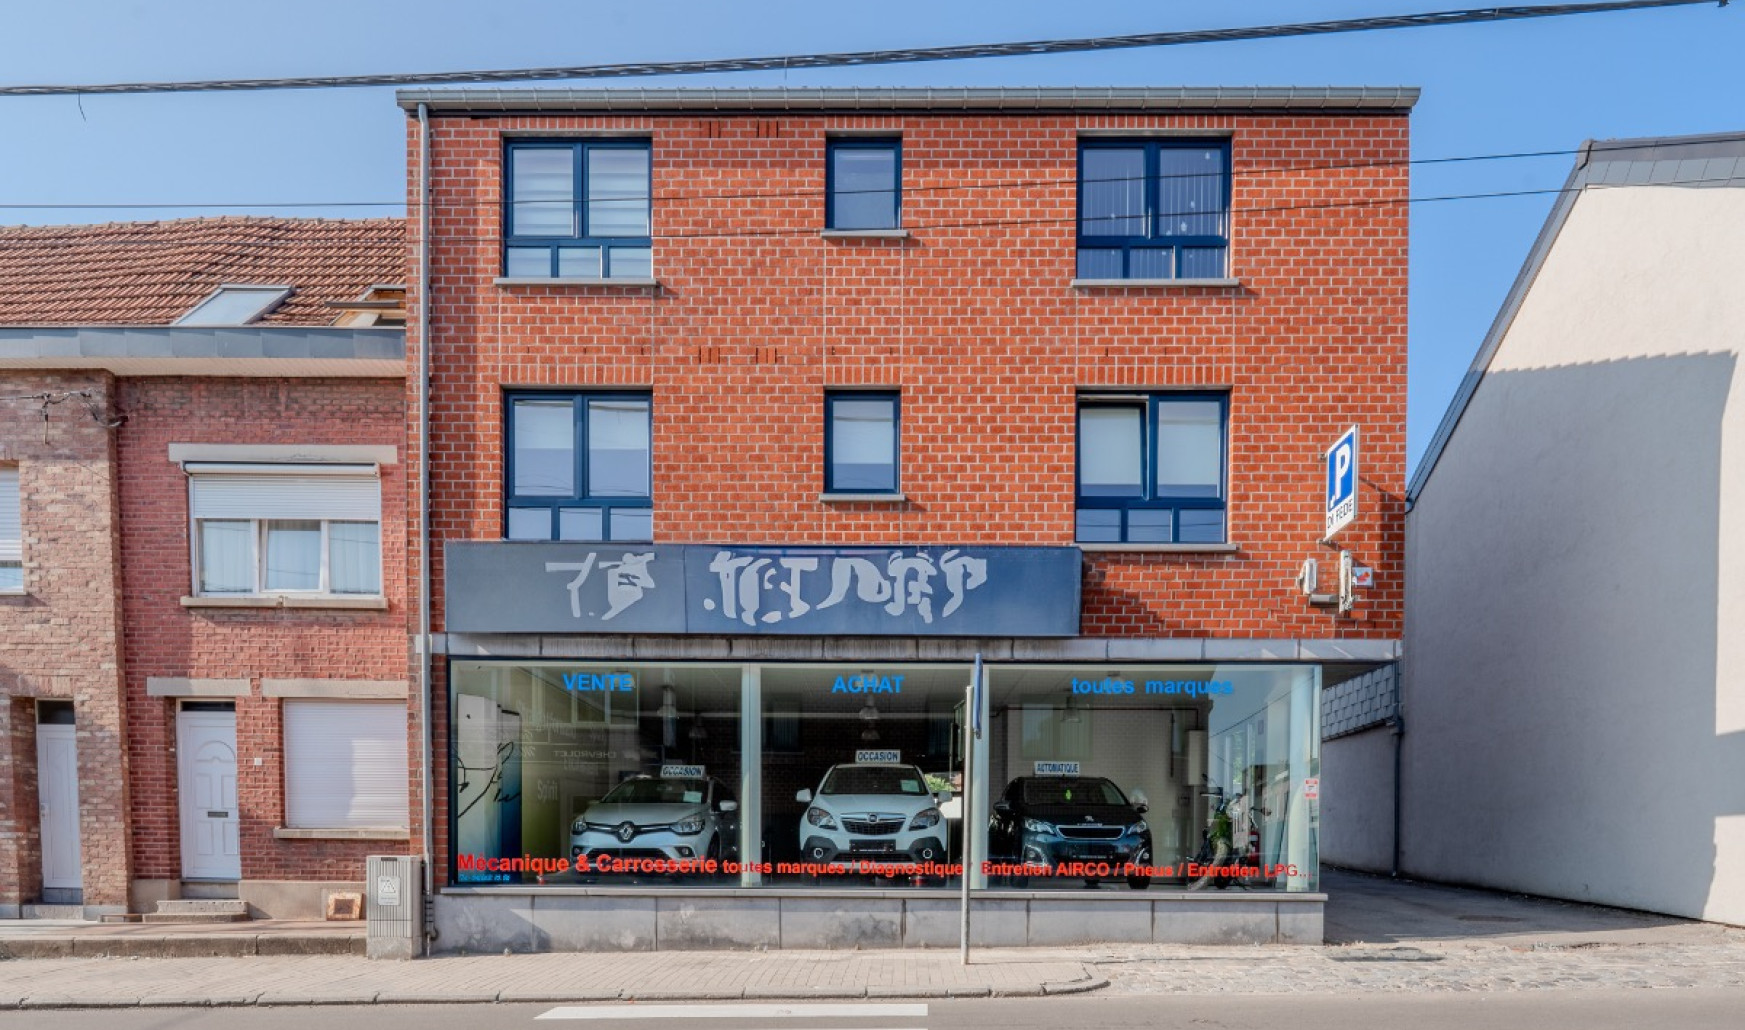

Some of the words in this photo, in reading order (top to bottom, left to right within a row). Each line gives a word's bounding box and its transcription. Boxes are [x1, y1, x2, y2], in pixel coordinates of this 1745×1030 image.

[1335, 443, 1352, 500] P
[562, 673, 633, 692] VENTE
[832, 675, 905, 693] ACHAT
[1071, 677, 1136, 695] toutes
[1144, 679, 1235, 699] marques
[857, 751, 899, 761] OCCASION
[662, 766, 702, 776] OCCASION
[1037, 763, 1079, 773] AUTOMATIQUE
[457, 853, 570, 875] Mécanique
[575, 853, 591, 873] &
[596, 853, 718, 874] Carrosserie
[722, 860, 773, 874] toutes
[777, 862, 845, 876] marques
[858, 860, 963, 877] Diagnostique
[981, 861, 1053, 876] Entretien
[1056, 862, 1110, 876] AIRCO
[1114, 862, 1121, 876] /
[1124, 862, 1174, 877] Pneus
[1177, 863, 1184, 877] /
[1187, 862, 1260, 877] Entretien
